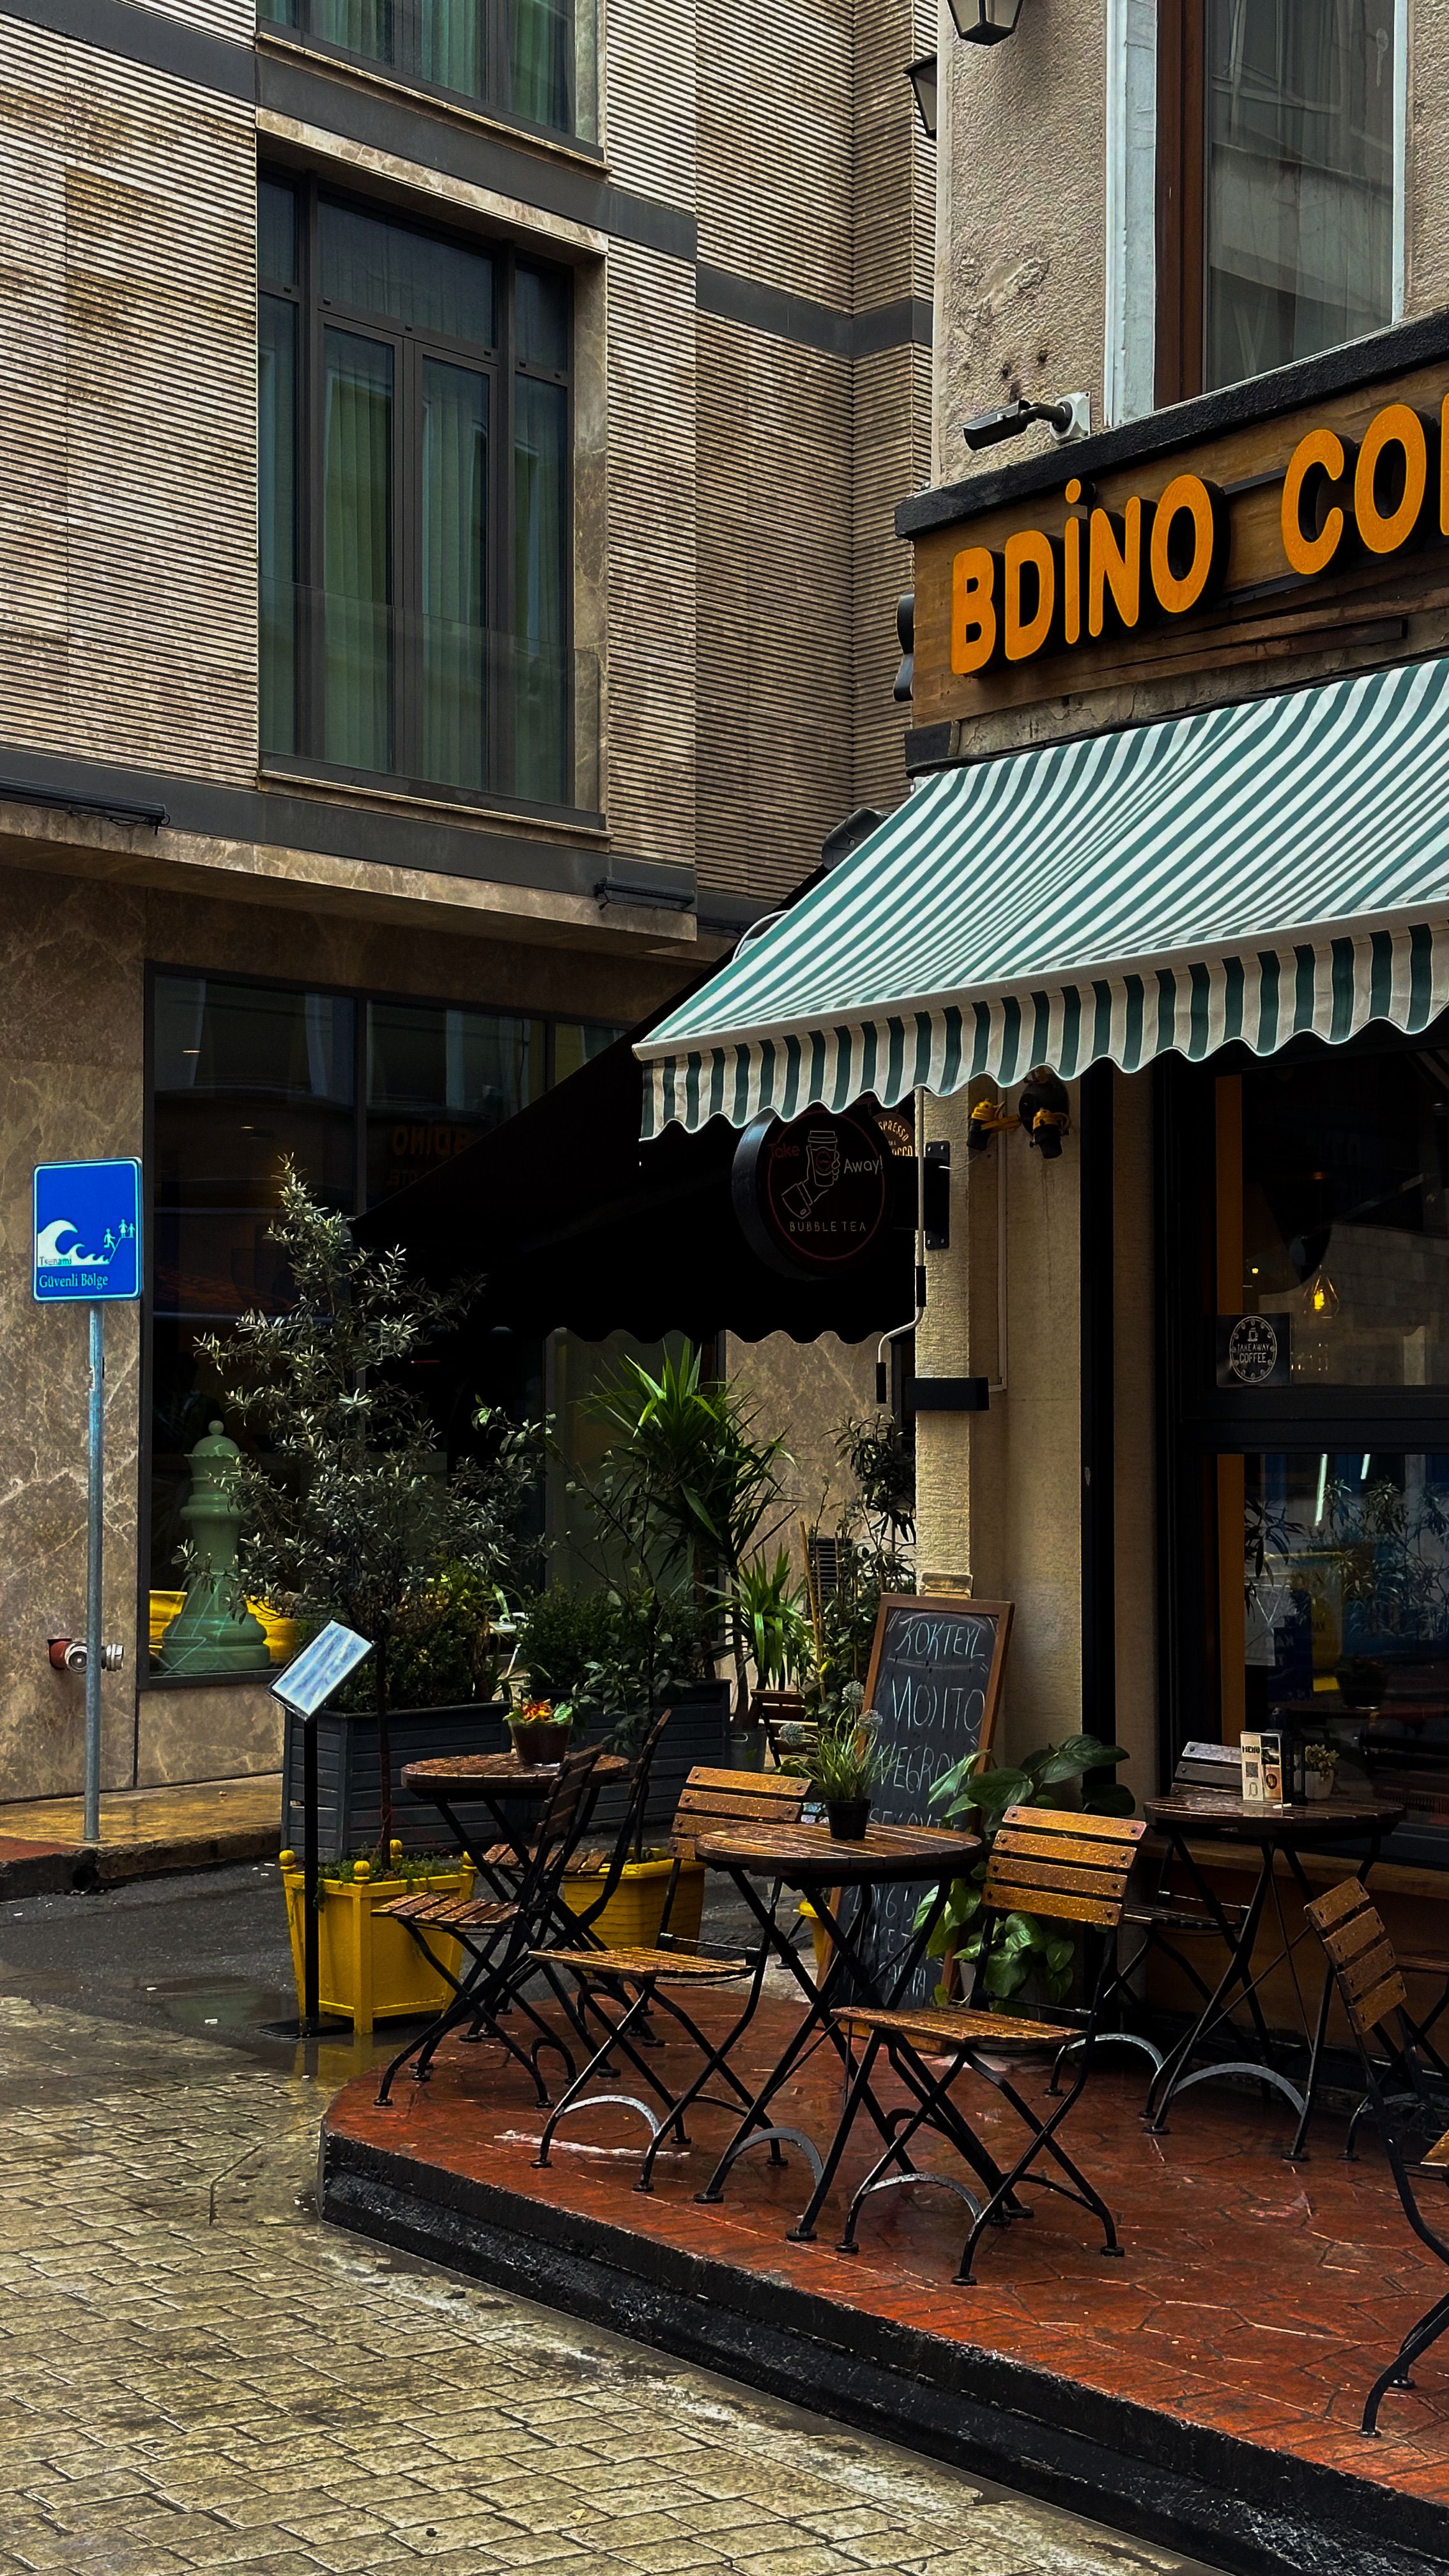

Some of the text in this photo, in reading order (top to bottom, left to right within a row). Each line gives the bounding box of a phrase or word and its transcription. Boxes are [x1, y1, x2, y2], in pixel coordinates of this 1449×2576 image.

[1281, 392, 1449, 575] CO
[878, 1120, 909, 1142] SPRESSO
[767, 1140, 801, 1160] Take
[843, 1154, 884, 1175] Away!
[790, 1221, 866, 1232] BUBBLE TEA
[39, 1272, 109, 1290] Güvenli Bölge
[1239, 1352, 1267, 1363] COFFEE
[895, 1619, 985, 1661] KOKTEYL
